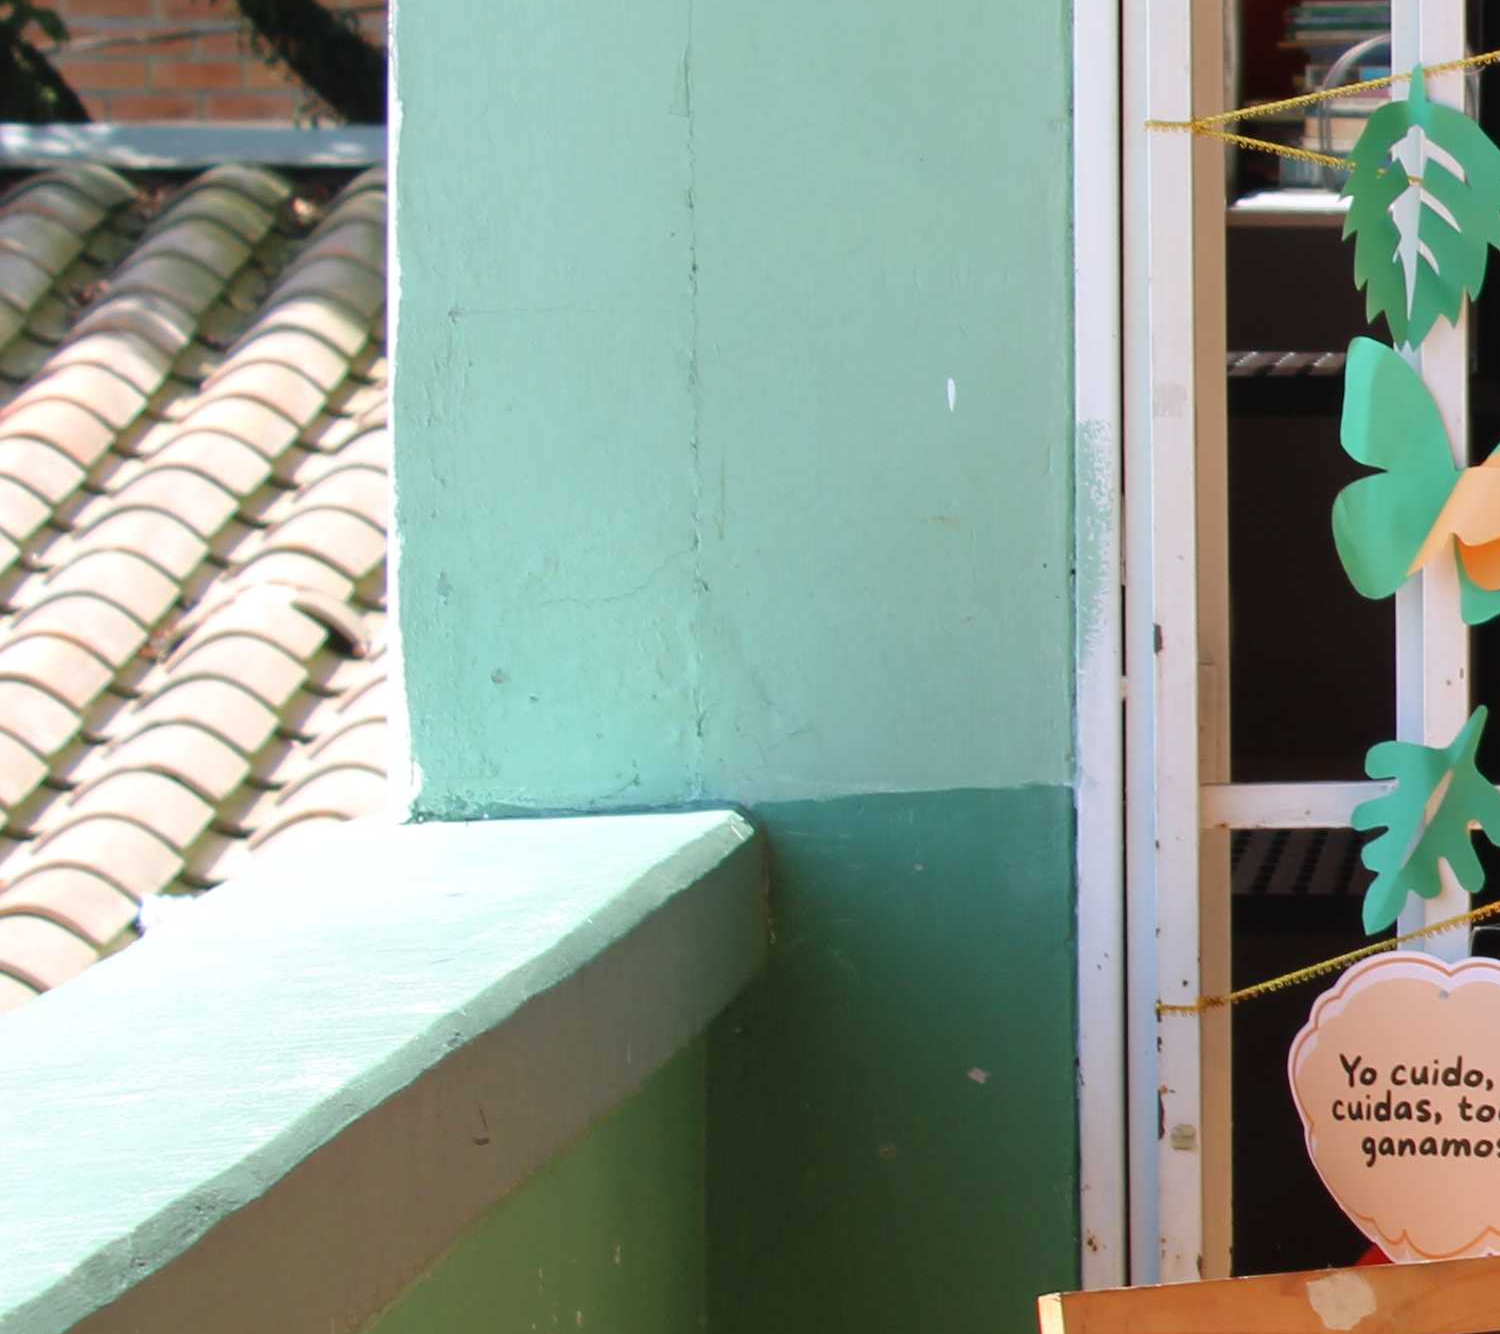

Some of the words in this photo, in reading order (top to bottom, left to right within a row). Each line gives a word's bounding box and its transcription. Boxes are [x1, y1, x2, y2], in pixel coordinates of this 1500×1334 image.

[1339, 1053, 1377, 1088] Yo
[1390, 1055, 1494, 1091] cuido,
[1331, 1090, 1442, 1125] cuidas,
